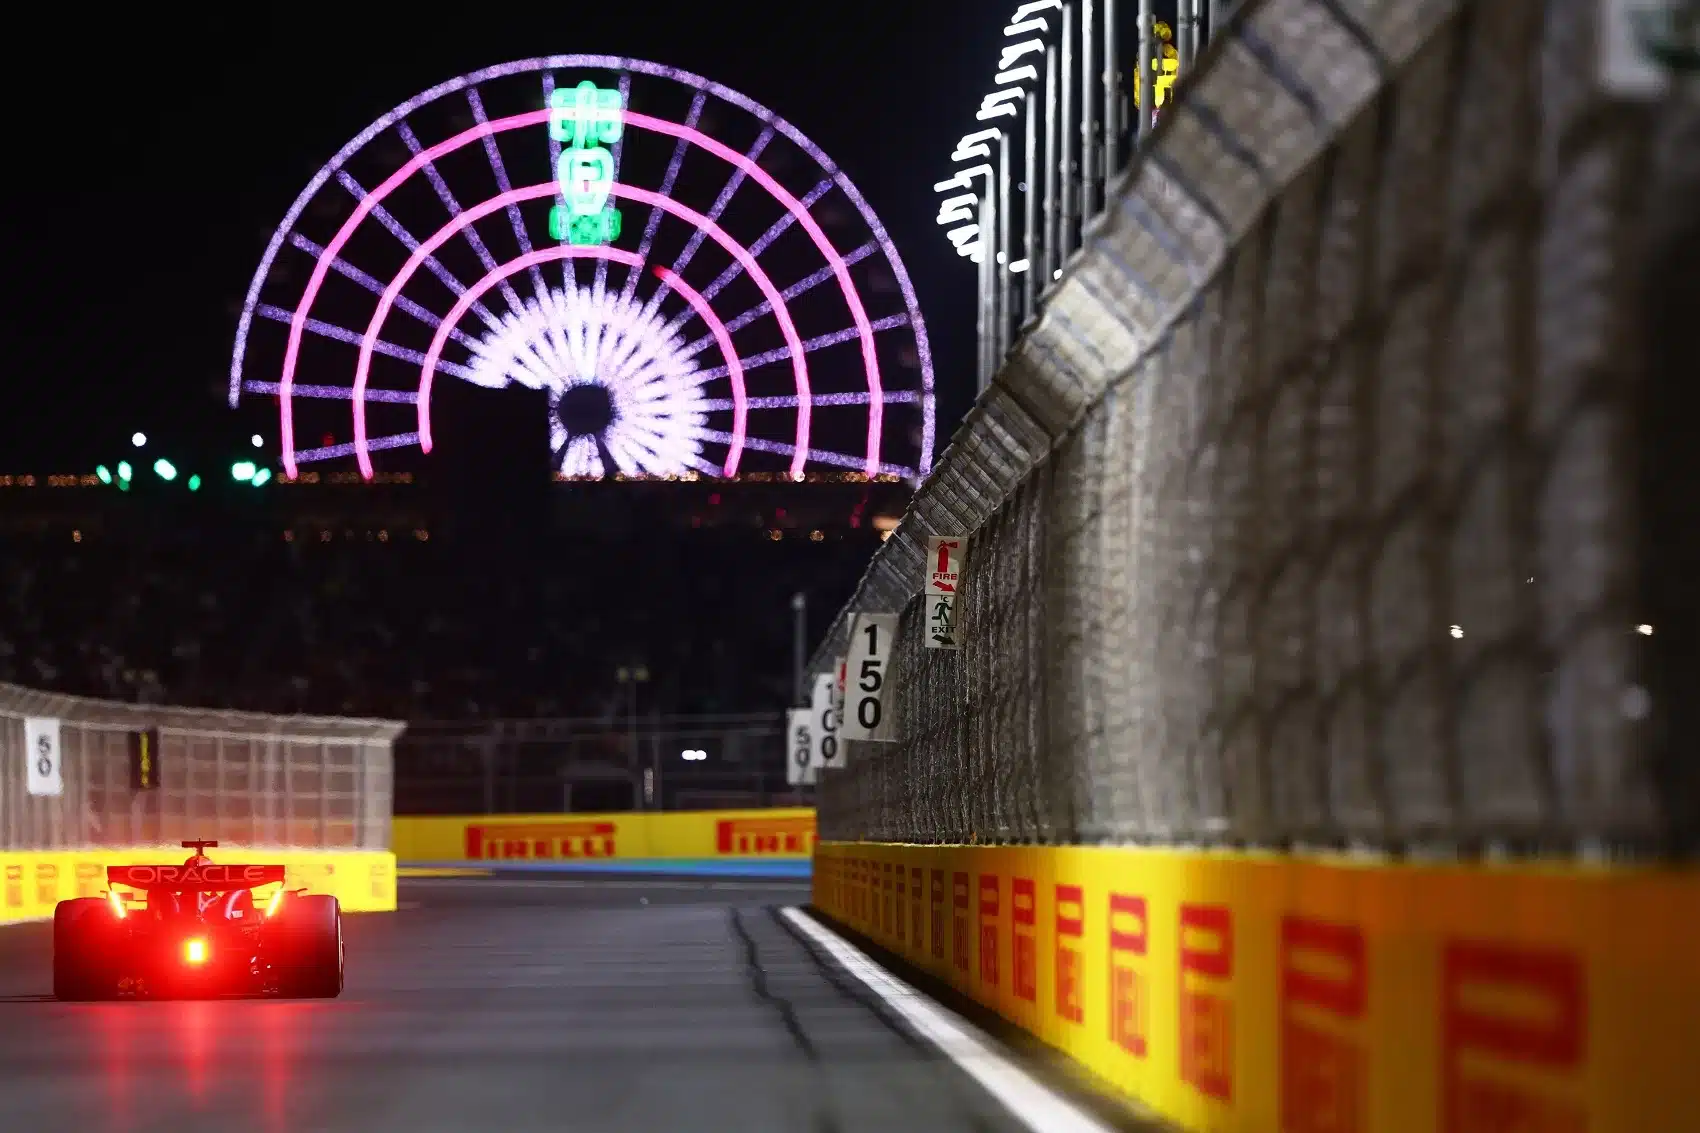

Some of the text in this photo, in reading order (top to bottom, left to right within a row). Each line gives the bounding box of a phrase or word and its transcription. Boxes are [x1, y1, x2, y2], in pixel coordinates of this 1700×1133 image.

[932, 572, 958, 580] FIRE
[931, 626, 956, 634] EXIT
[858, 624, 883, 729] 150
[821, 682, 838, 760] 100
[38, 733, 53, 778] 50
[465, 822, 616, 860] PIRELLI
[127, 866, 265, 883] ORACLE
